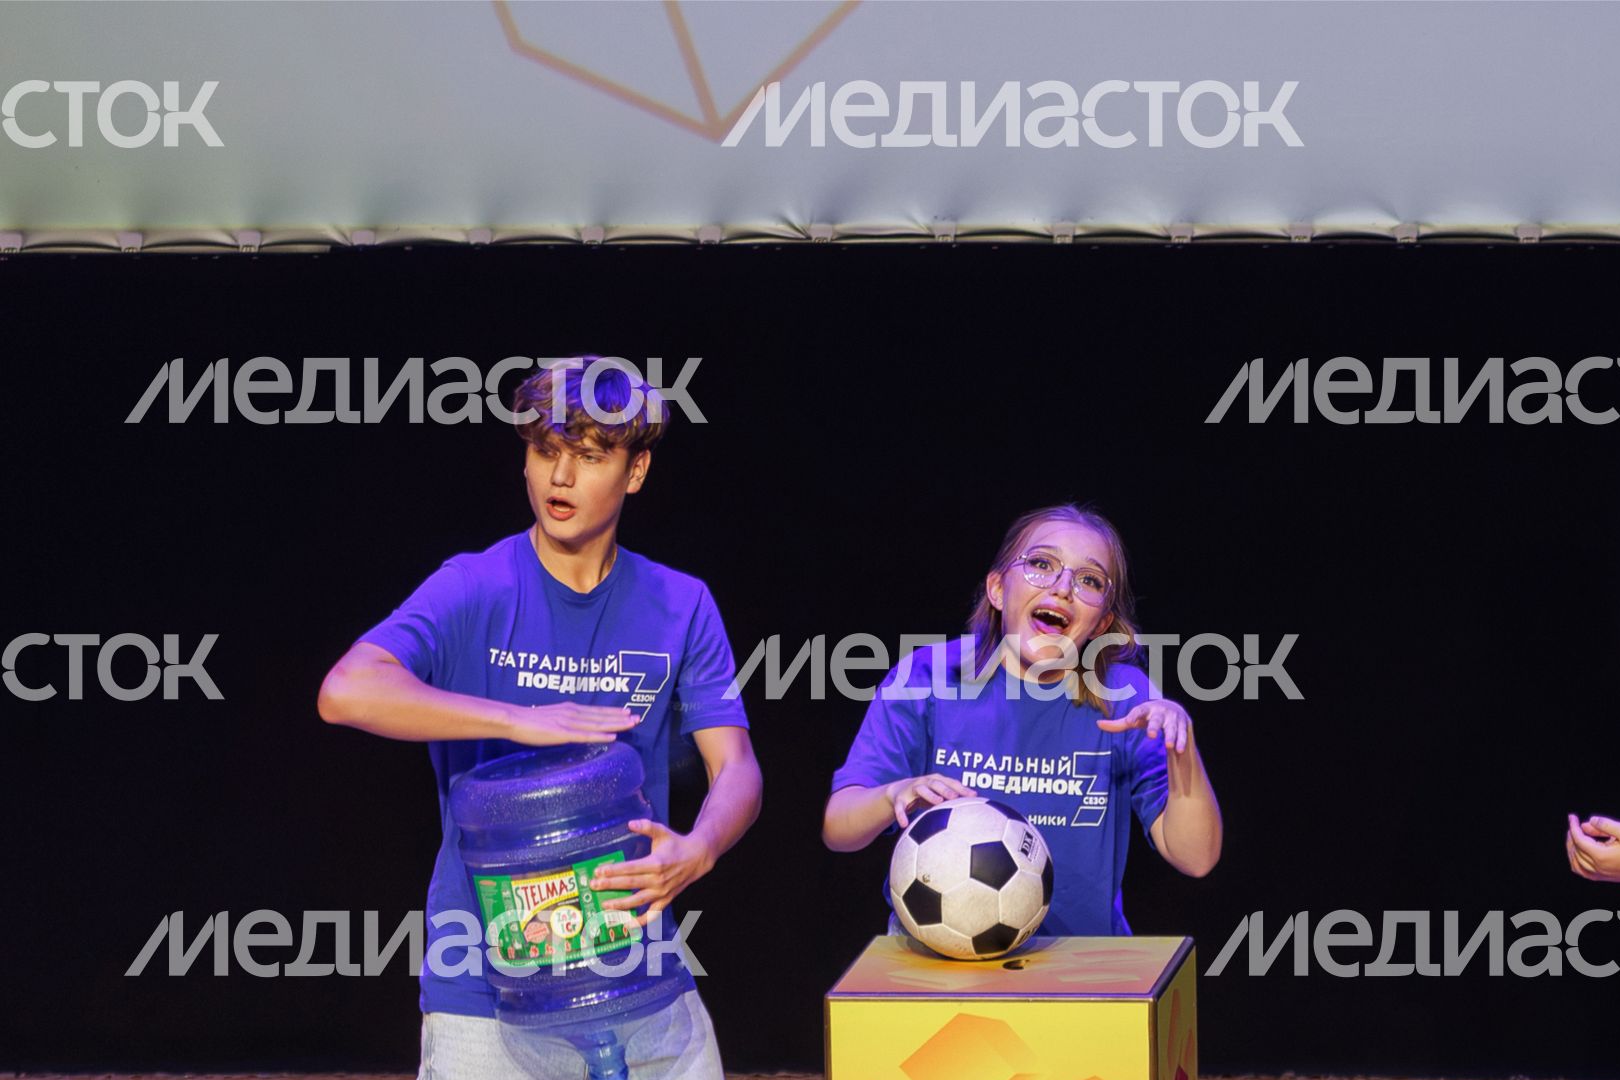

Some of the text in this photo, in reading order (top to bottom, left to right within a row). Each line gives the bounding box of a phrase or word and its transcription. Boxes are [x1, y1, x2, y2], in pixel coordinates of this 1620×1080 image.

[489, 648, 618, 674] ТЕАТРАЛЬНЫЙ
[517, 671, 630, 694] ПОЕДИНОК
[630, 694, 655, 703] СЕЗОН
[962, 771, 1084, 796] ПОЕДИНОК
[514, 876, 576, 916] STELMAS
